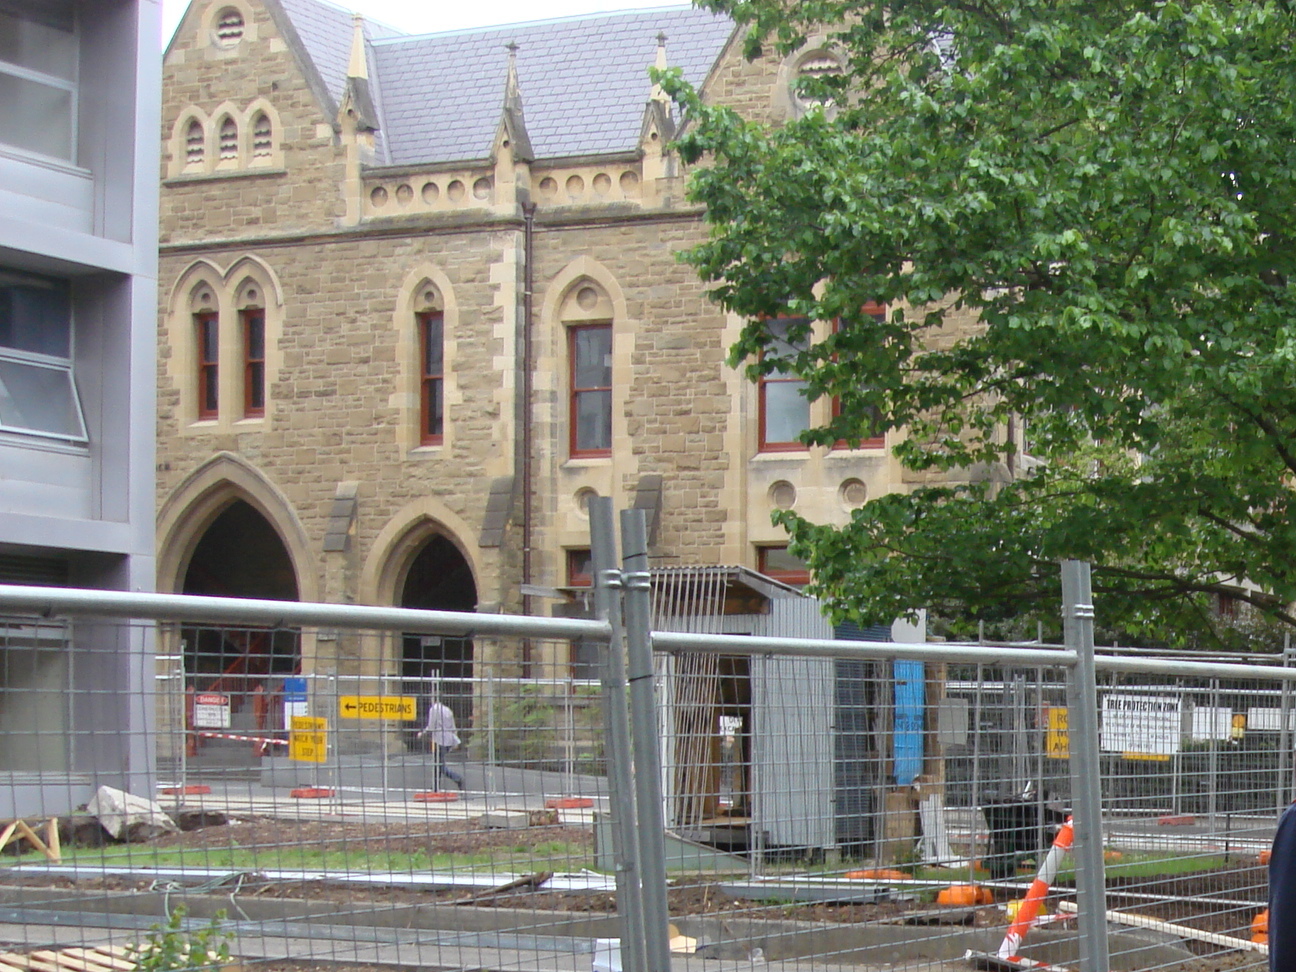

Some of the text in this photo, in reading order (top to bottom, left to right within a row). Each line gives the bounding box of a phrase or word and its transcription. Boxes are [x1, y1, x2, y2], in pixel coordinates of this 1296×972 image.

[358, 702, 412, 714] PEDESTRIANS
[1107, 699, 1122, 710] TREE
[1123, 700, 1161, 712] PROTECTION
